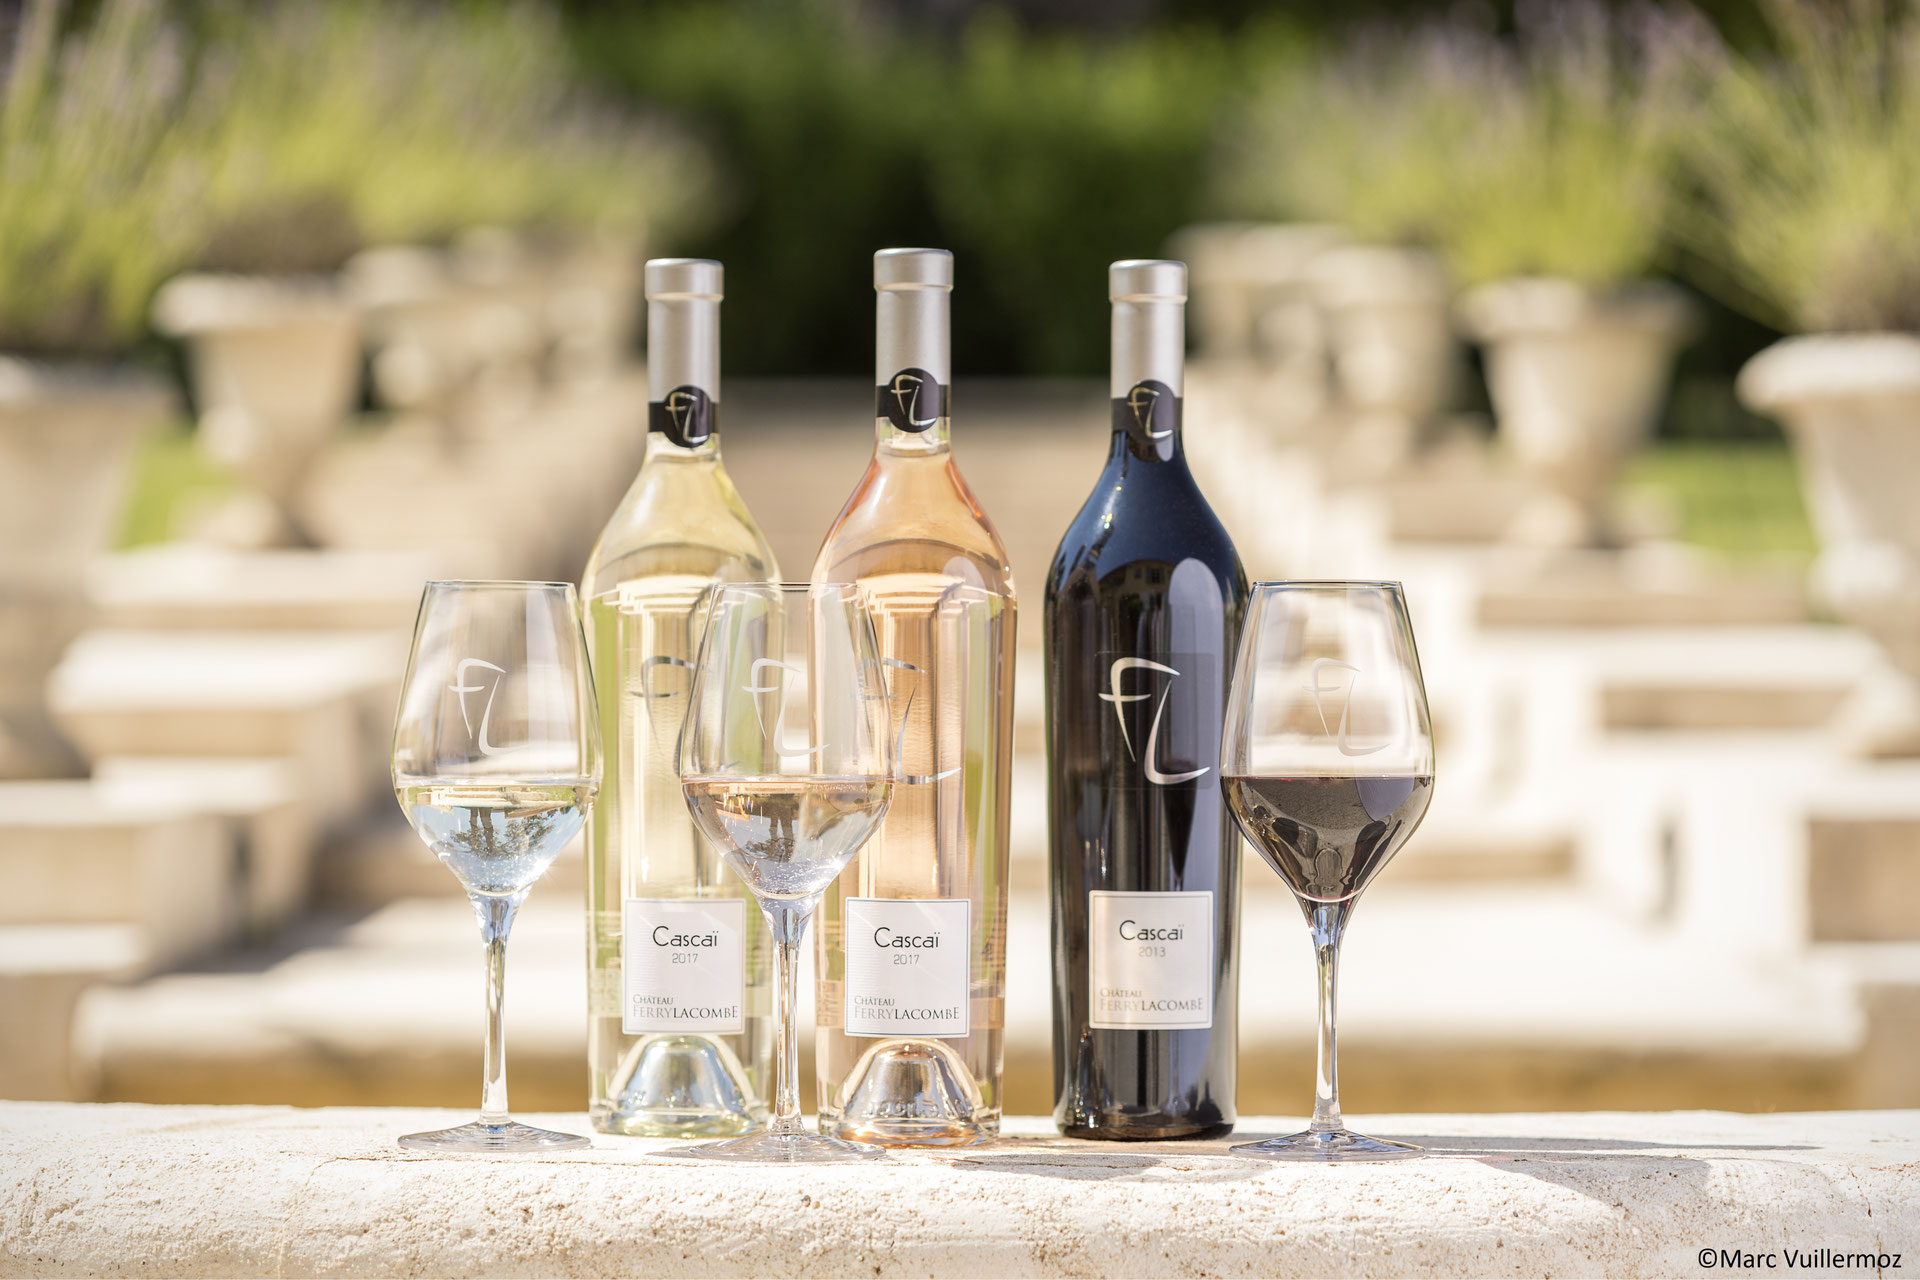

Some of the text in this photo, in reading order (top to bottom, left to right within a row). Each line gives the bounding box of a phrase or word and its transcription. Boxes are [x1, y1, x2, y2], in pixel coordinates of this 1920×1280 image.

[652, 925, 719, 947] Cascaï
[874, 927, 941, 948] Cascaï
[1119, 919, 1185, 941] Cascaï
[672, 953, 698, 964] 2017
[893, 954, 920, 965] 2017
[1138, 946, 1166, 958] 2013
